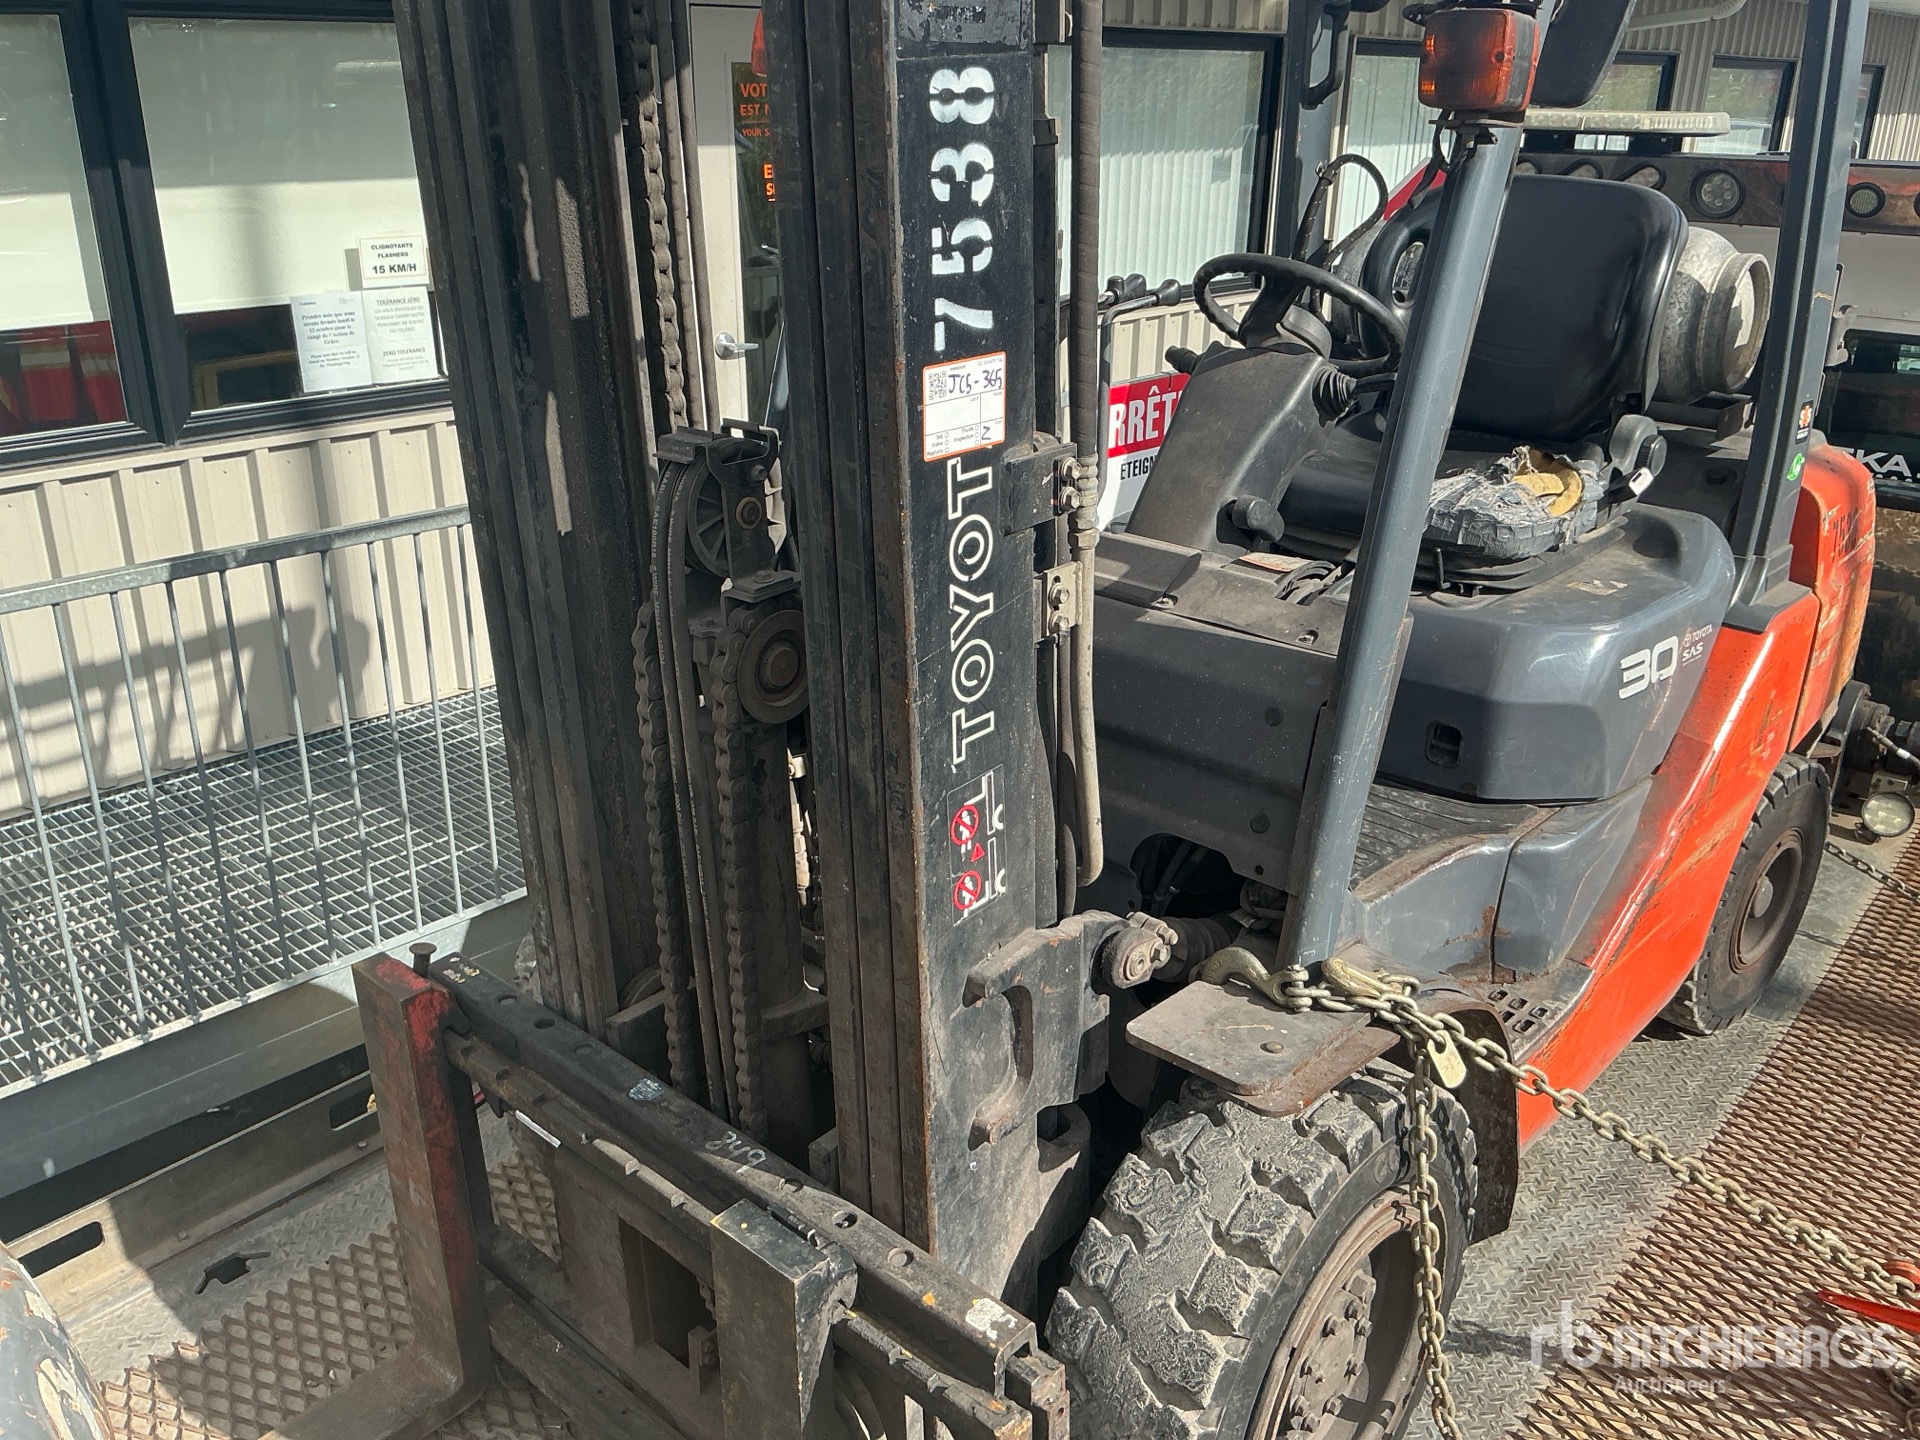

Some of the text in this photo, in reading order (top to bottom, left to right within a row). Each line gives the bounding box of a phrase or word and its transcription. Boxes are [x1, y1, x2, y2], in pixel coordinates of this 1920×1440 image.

[740, 104, 760, 116] EST
[742, 128, 761, 136] YOUR
[930, 67, 995, 352] 7538
[371, 242, 413, 250] CLIGNOTANTS
[377, 251, 409, 259] FLASHERS
[372, 262, 417, 275] 15 KM/H
[1109, 385, 1182, 449] RRÊT
[947, 446, 995, 765] TOYOT
[1692, 624, 1713, 642] TOYOTA
[1682, 641, 1704, 662] SAS
[1619, 635, 1679, 699] 30
